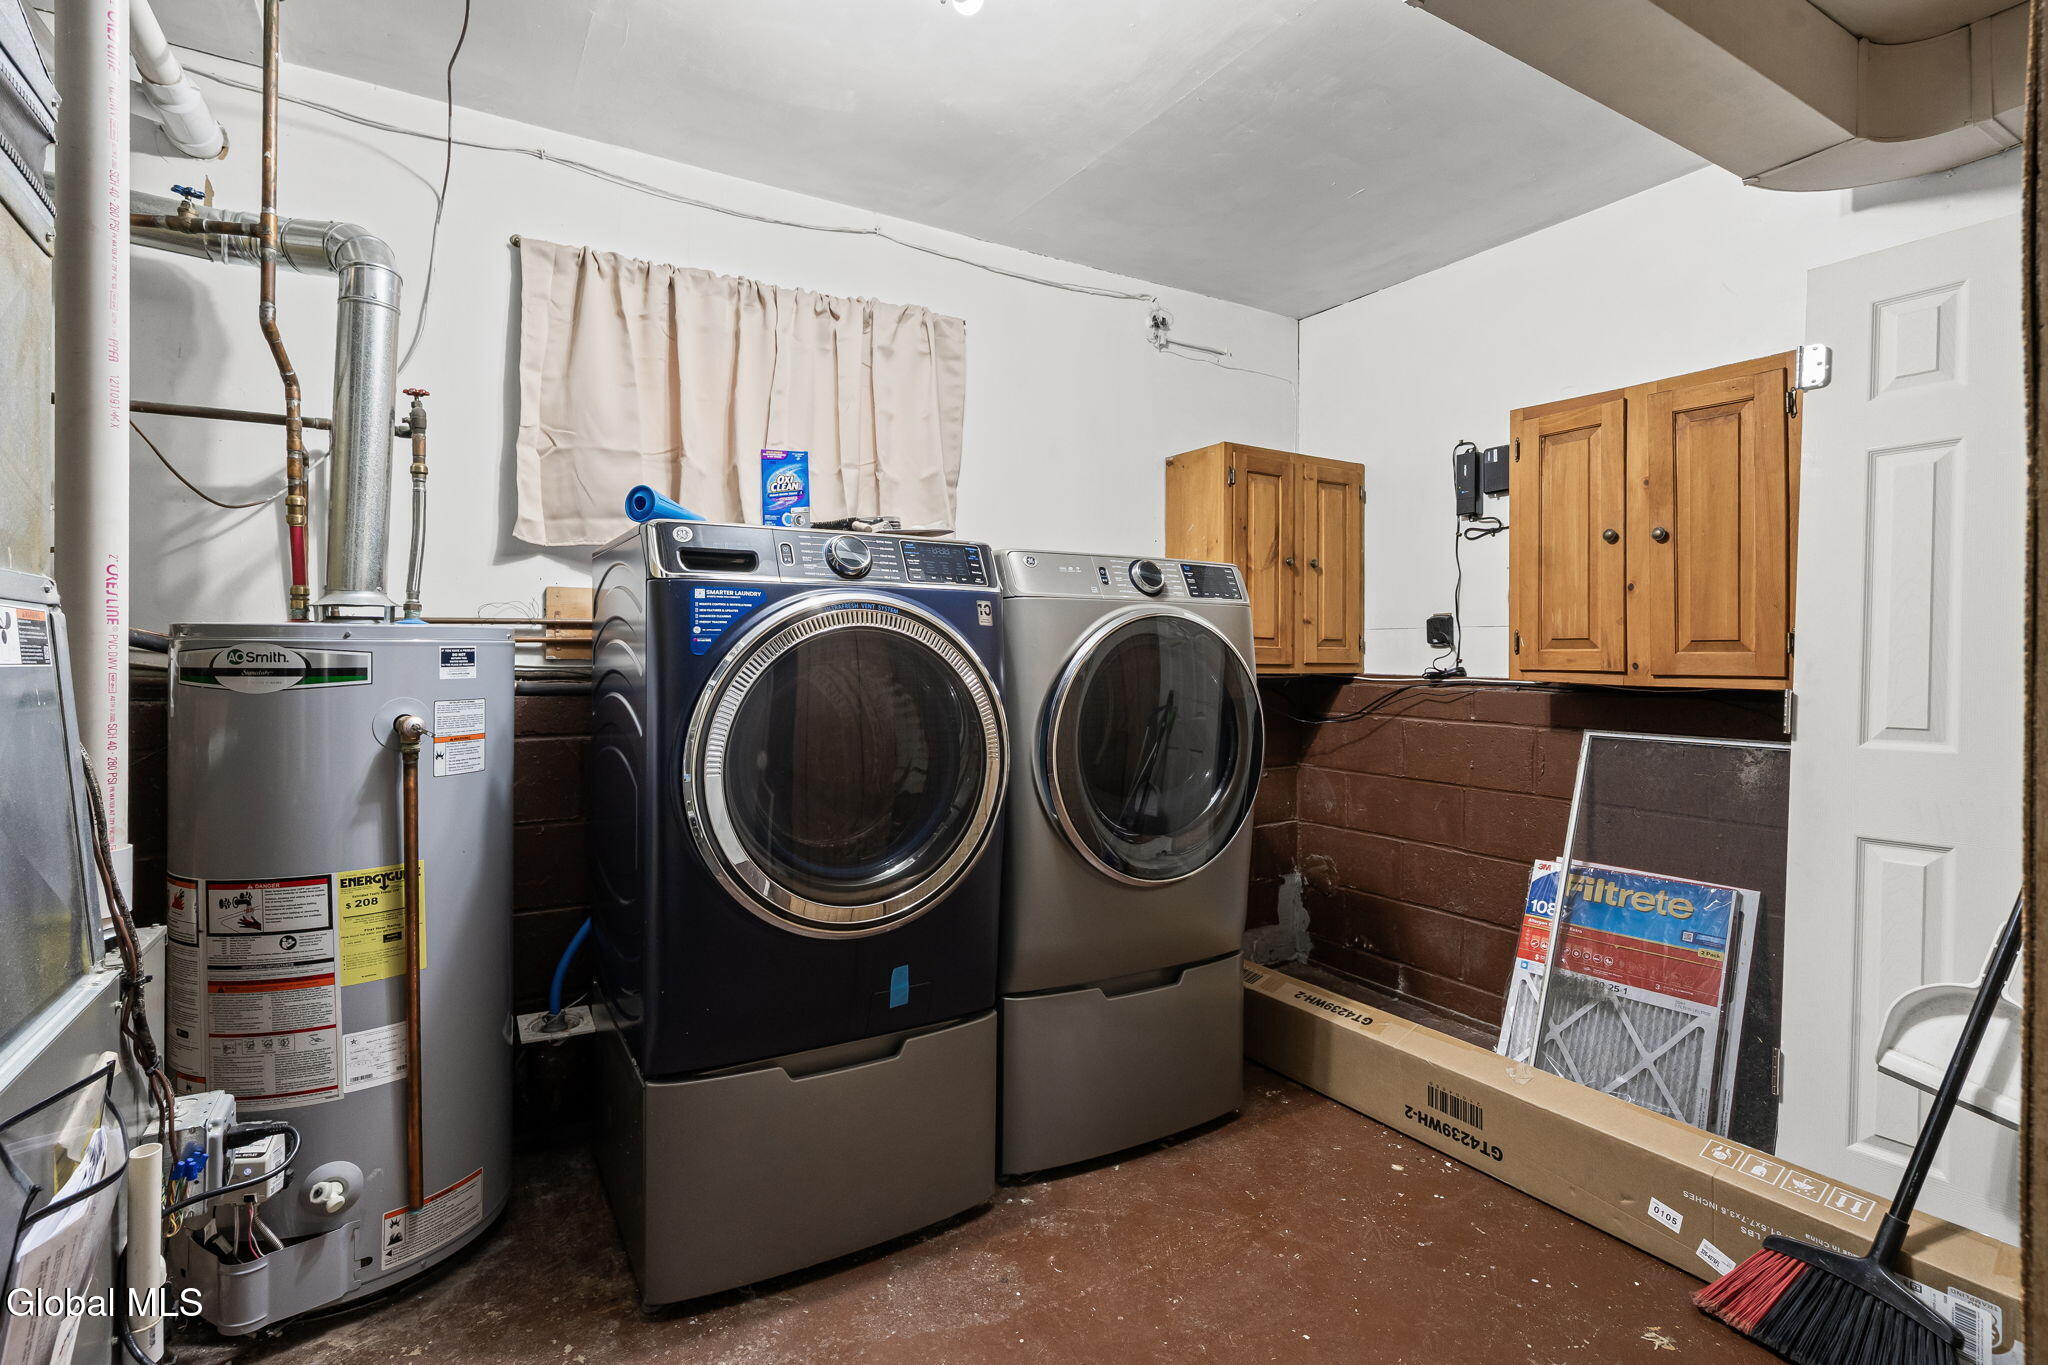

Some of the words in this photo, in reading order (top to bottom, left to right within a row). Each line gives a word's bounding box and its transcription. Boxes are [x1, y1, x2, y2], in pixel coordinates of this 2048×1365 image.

[109, 202, 120, 217] 280
[109, 217, 120, 232] PSI
[770, 482, 799, 492] CLEAN
[777, 475, 794, 484] OXI
[861, 602, 875, 610] VENT
[877, 604, 899, 614] SYSTEM
[108, 634, 119, 649] PVC
[108, 651, 119, 671] DWV
[107, 723, 117, 739] SCH
[107, 740, 117, 751] 40
[107, 756, 117, 771] 280
[107, 772, 118, 785] PSI
[1537, 863, 1552, 871] 3M
[345, 902, 352, 910] $
[354, 897, 379, 908] 208
[1565, 873, 1695, 919] Filtrete
[1570, 926, 1583, 934] Extra
[1706, 951, 1721, 959] Pack
[1294, 990, 1373, 1026] GT4239WH-2
[1404, 1104, 1504, 1162] GT4239WH-2
[1682, 1190, 1718, 1210] INCHES
[1653, 1205, 1678, 1226] 0105
[1740, 1225, 1761, 1240] LBS
[1805, 1233, 1830, 1248] China
